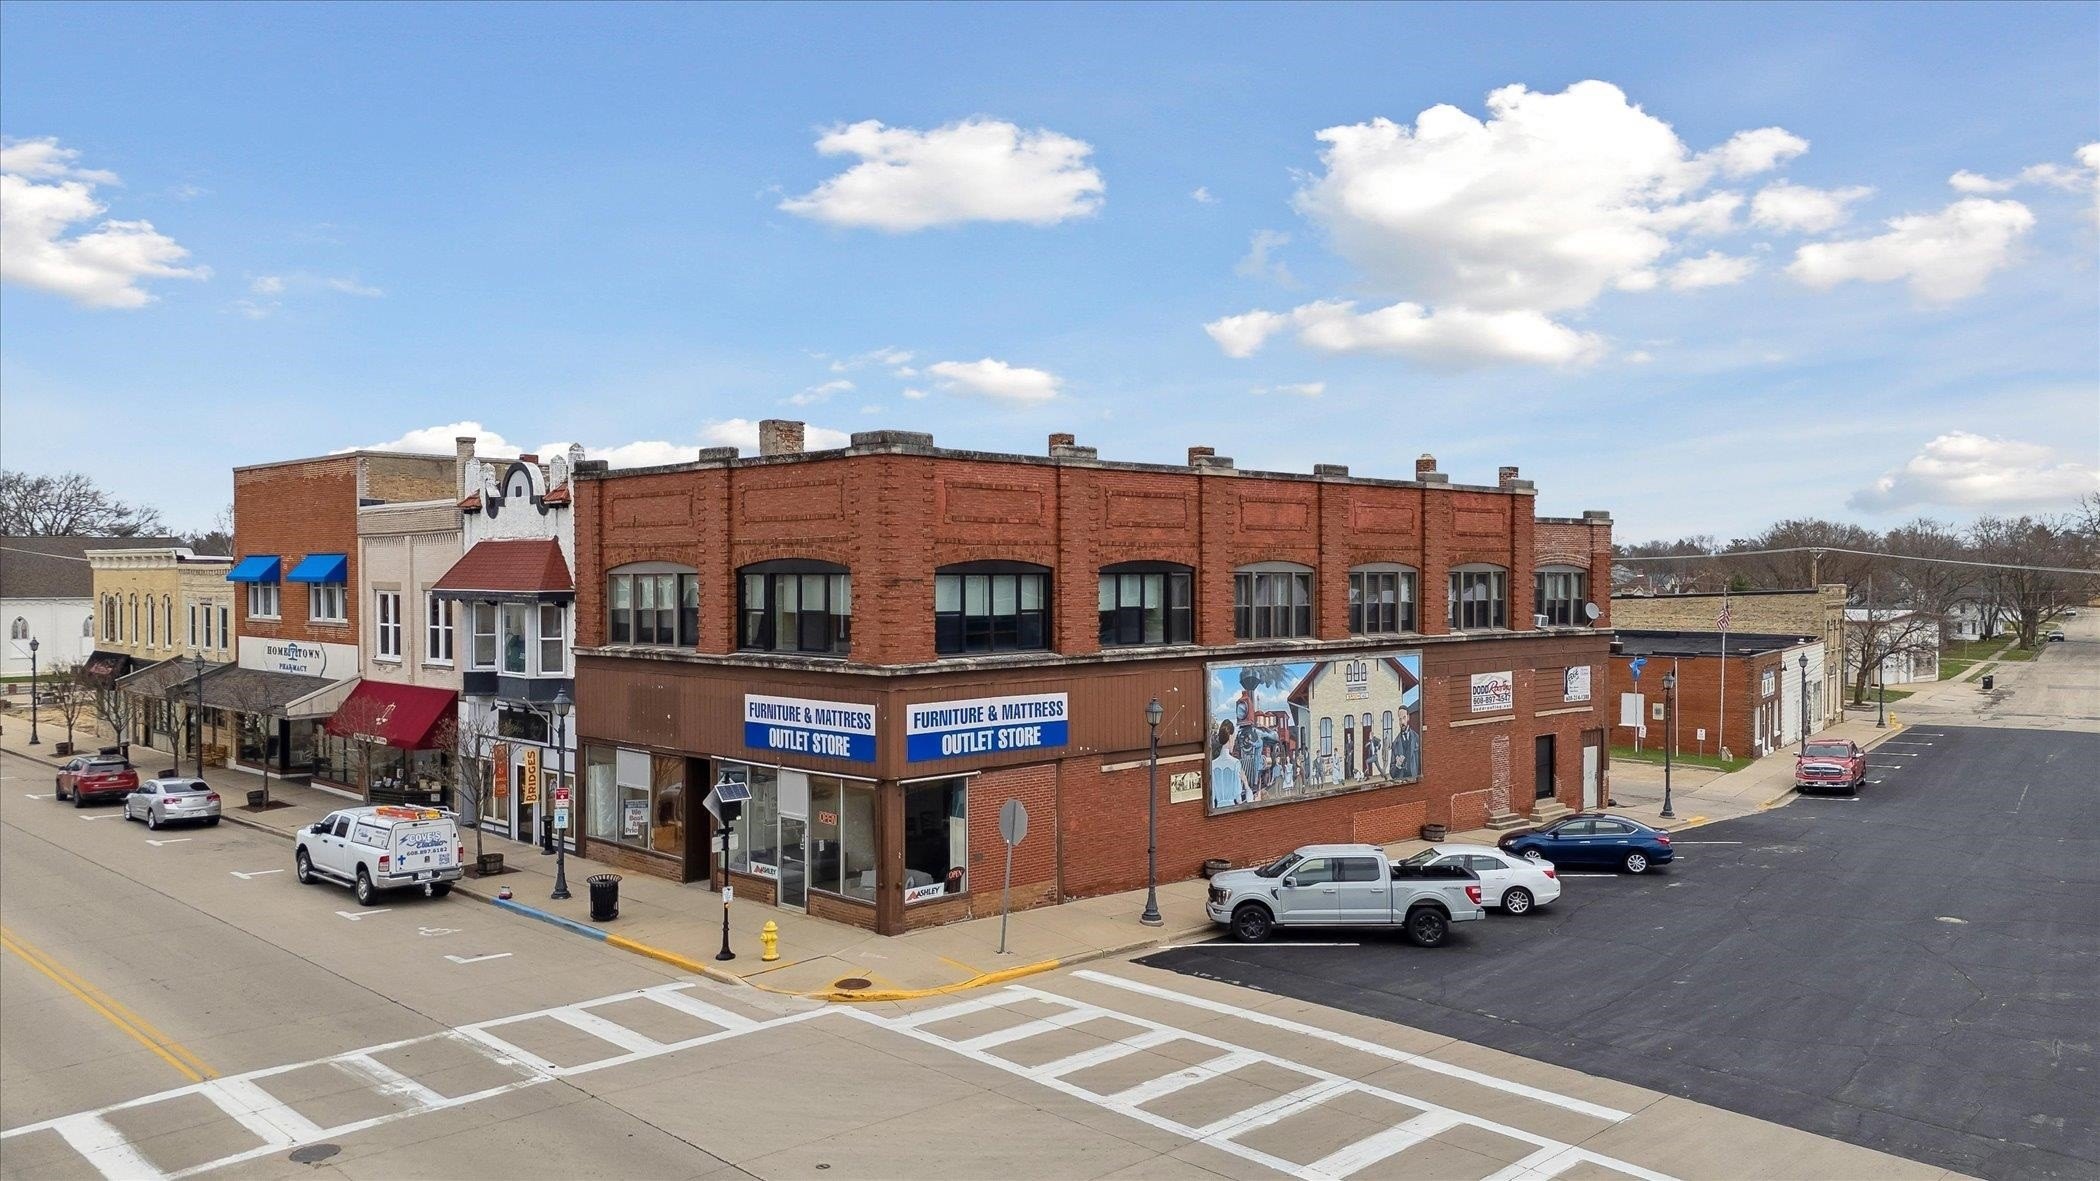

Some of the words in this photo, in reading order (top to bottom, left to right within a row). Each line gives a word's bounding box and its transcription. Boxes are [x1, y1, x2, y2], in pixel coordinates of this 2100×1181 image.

[279, 663, 307, 673] PHARMACY
[1473, 684, 1489, 696] DODD
[749, 702, 801, 722] FURNITURE
[804, 707, 812, 724] &
[815, 708, 871, 730] MATTRESS
[914, 706, 984, 729] FURNITURE
[988, 705, 997, 721] &
[1002, 700, 1063, 721] MATTRESS
[769, 727, 809, 752] OUTLET
[812, 732, 850, 757] STORE
[941, 729, 994, 756] OUTLET
[998, 725, 1041, 749] STORE
[526, 750, 537, 802] BRIDGES
[820, 811, 837, 825] OPEN
[948, 869, 962, 879] OPEN
[916, 886, 940, 898] ASHLEY
